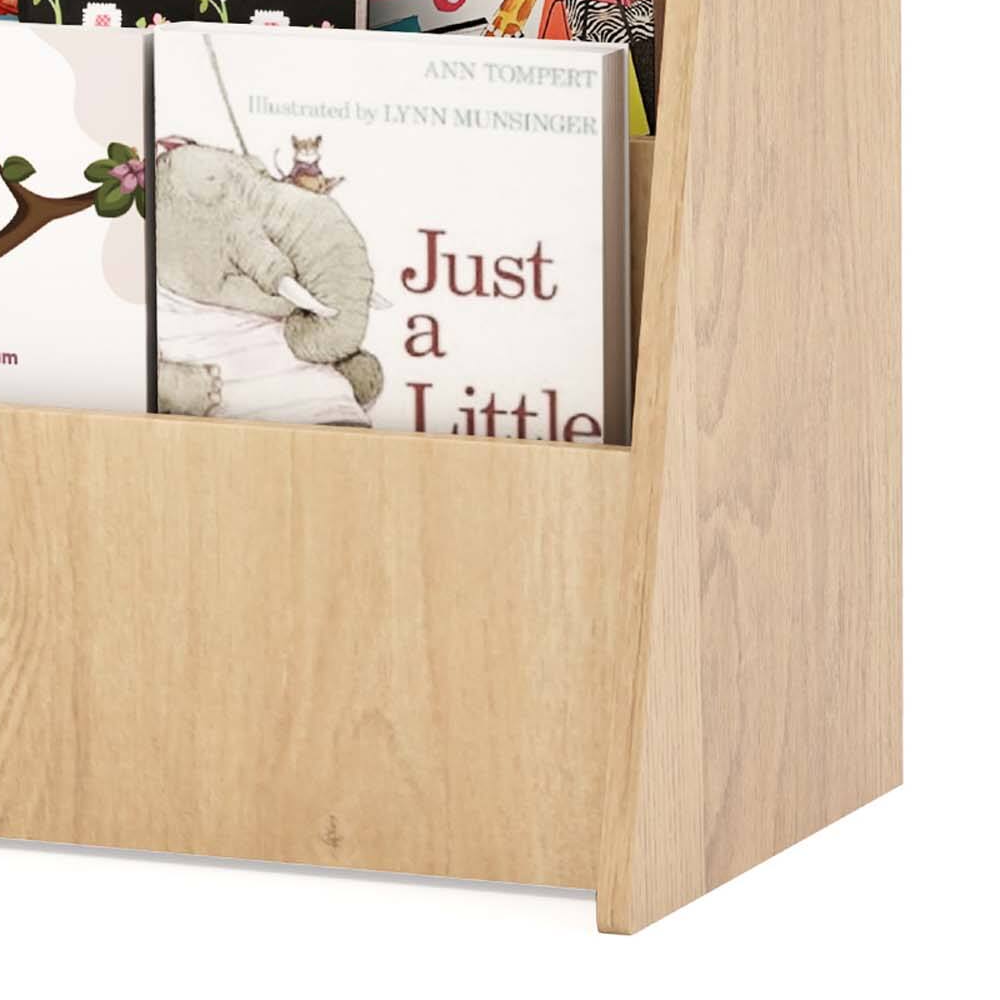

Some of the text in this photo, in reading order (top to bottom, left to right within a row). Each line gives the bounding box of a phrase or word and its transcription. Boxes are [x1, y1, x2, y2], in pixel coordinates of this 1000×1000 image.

[423, 60, 599, 89] ANN TOMPERT
[248, 94, 599, 136] Illustrated by LYNN MUNSINGER
[400, 227, 559, 302] Just
[404, 313, 447, 359] a
[406, 382, 602, 442] Little
